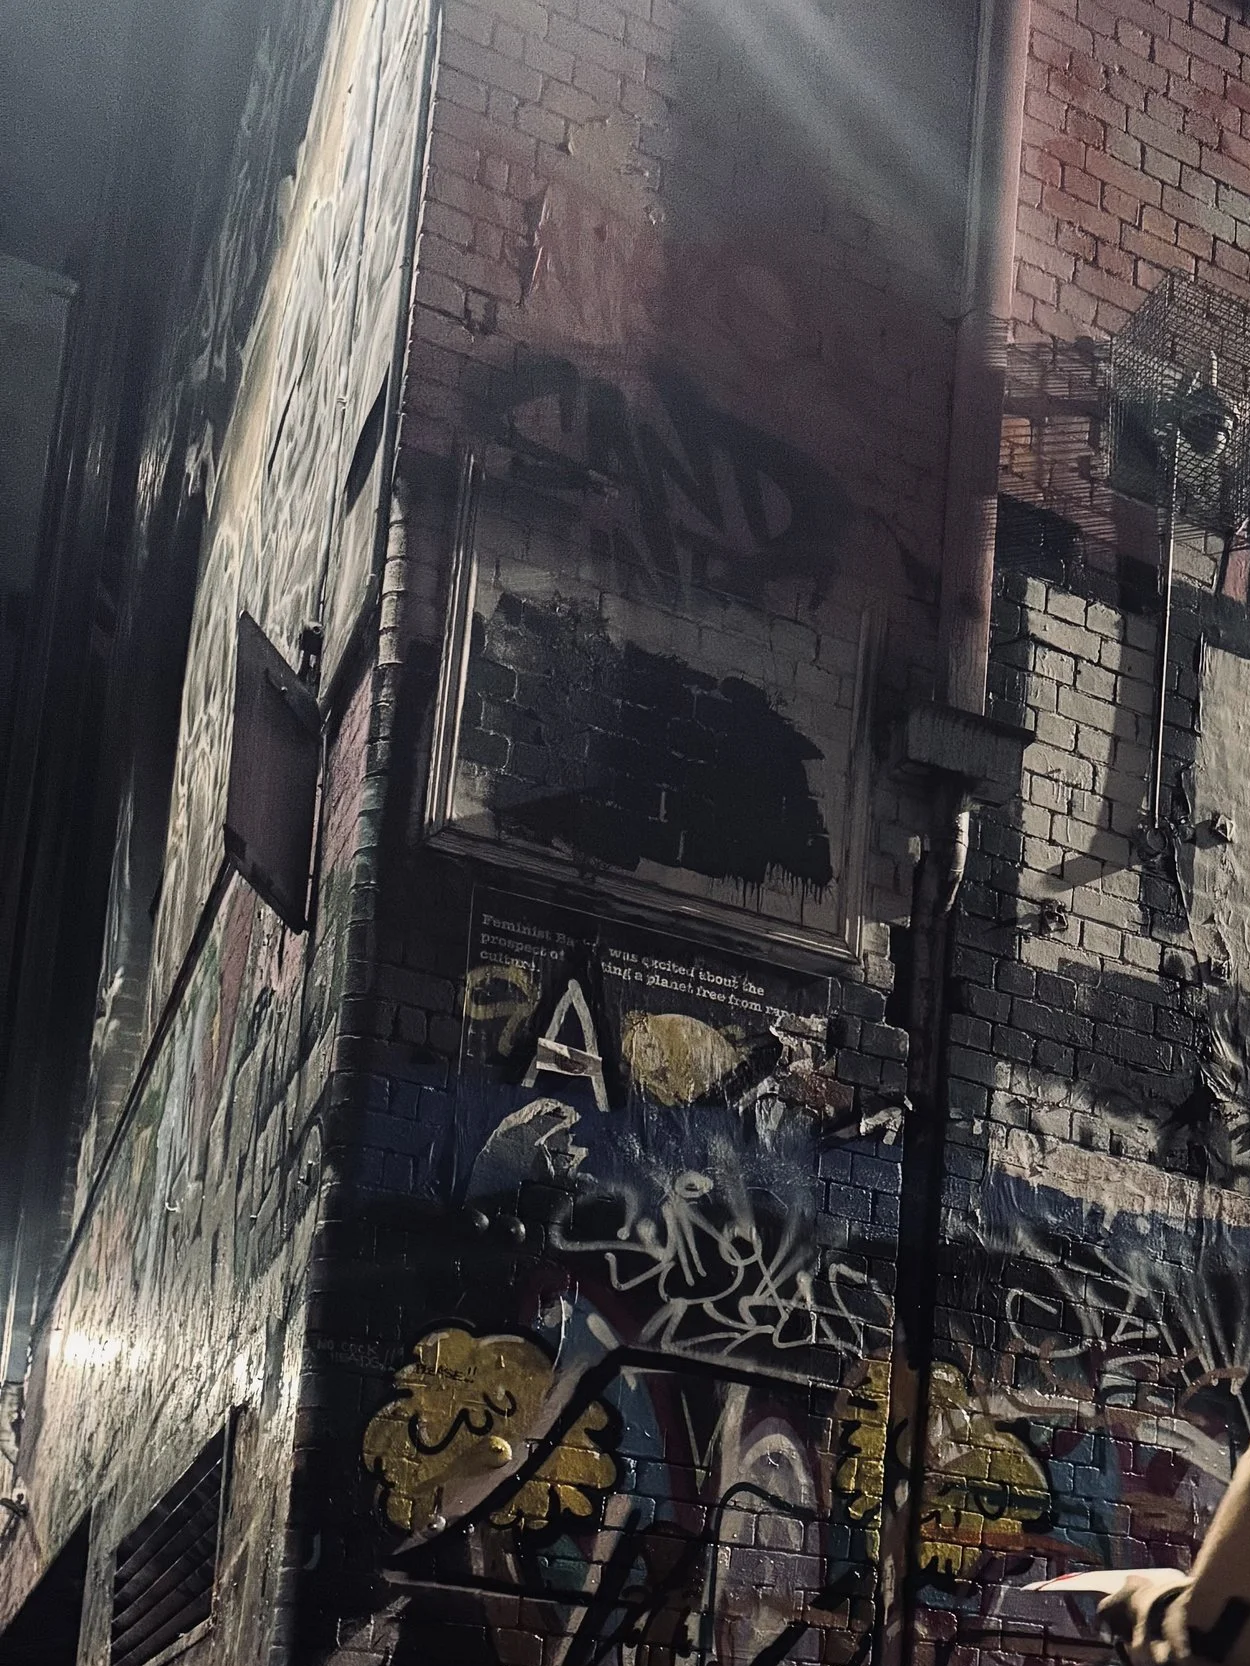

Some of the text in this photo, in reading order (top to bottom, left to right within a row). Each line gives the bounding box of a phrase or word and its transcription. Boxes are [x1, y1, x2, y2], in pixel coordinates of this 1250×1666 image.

[480, 932, 547, 957] prospect
[549, 945, 566, 962] of
[634, 970, 644, 983] a
[646, 974, 694, 994] planet
[695, 986, 726, 1003] free
[727, 994, 763, 1013] from
[481, 912, 552, 942] Feminist
[608, 947, 638, 964] was
[640, 955, 694, 978] excited
[698, 967, 739, 990] about
[742, 973, 765, 996] the
